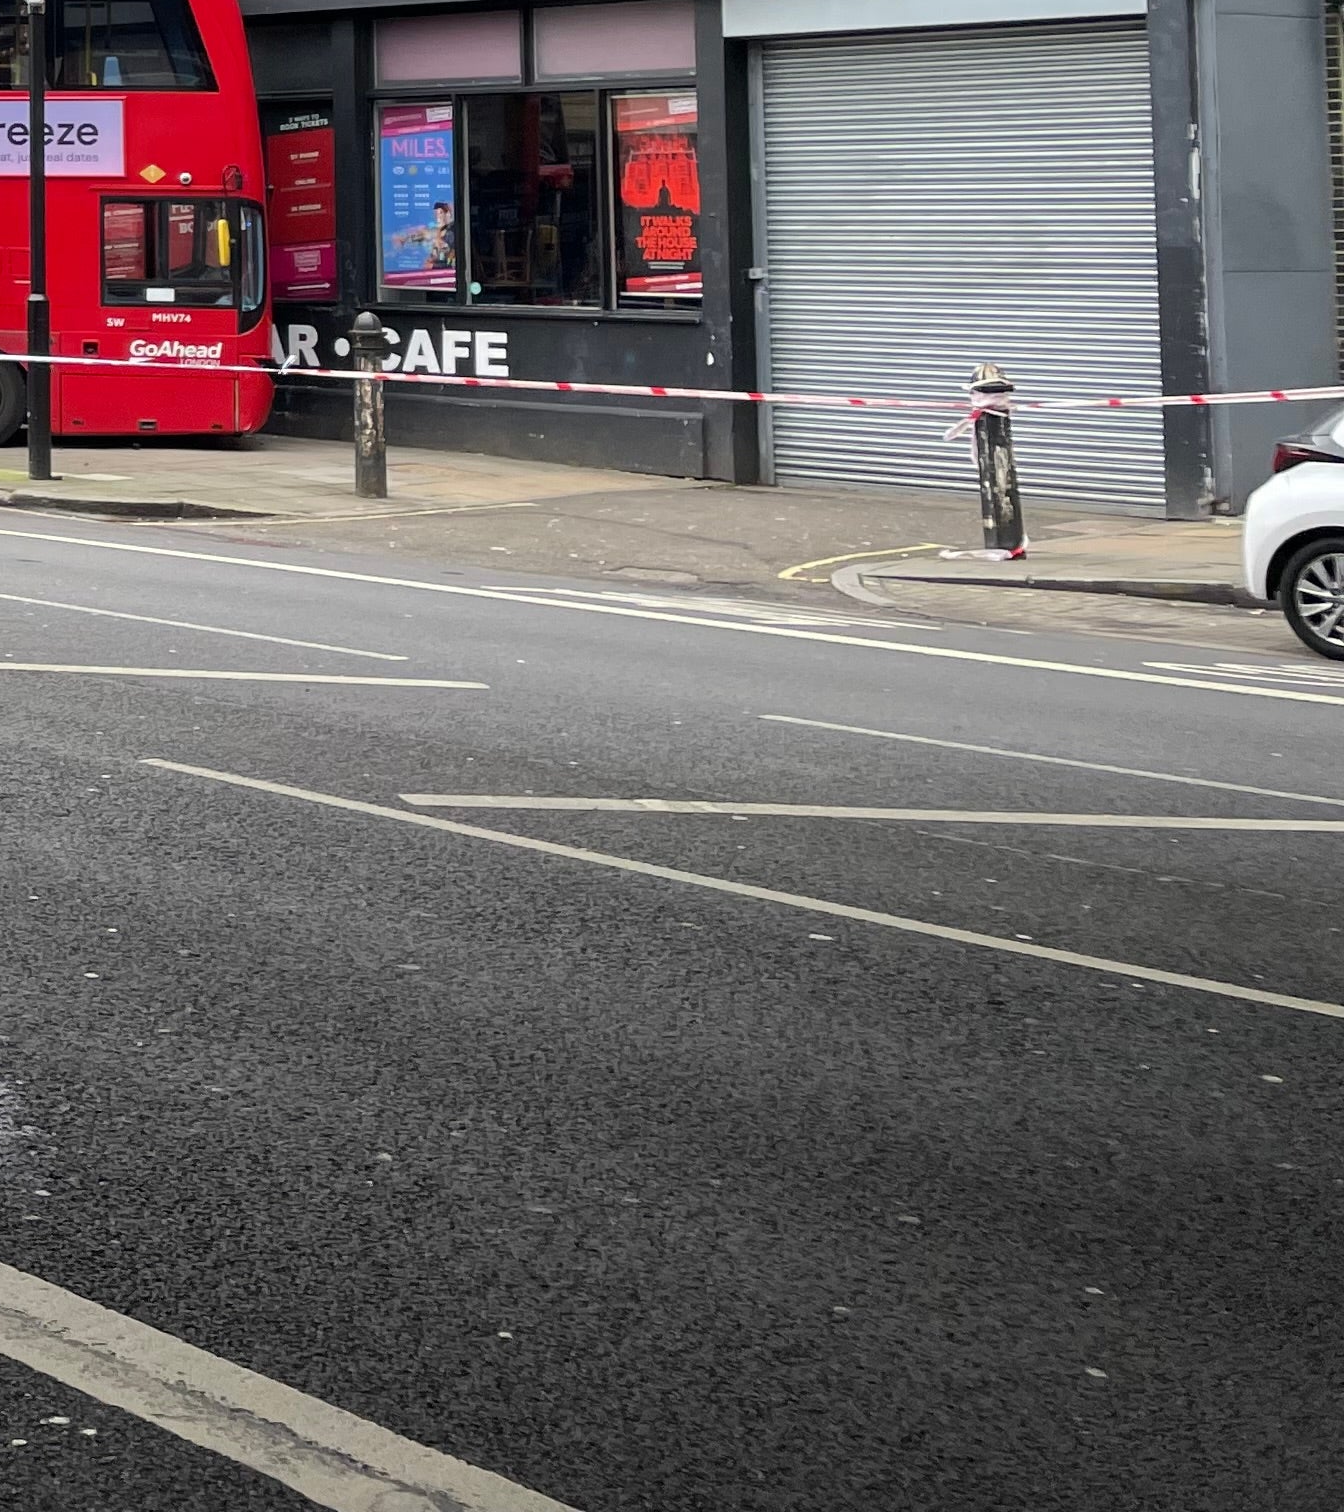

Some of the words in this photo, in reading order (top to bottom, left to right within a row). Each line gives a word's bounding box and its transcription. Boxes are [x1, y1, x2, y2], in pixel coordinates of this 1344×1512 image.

[300, 118, 328, 128] TICKETS
[17, 152, 31, 164] ju
[66, 152, 99, 162] dates
[651, 216, 692, 227] WALKS
[642, 227, 691, 237] AROUND
[635, 237, 657, 248] THE
[657, 237, 697, 249] HOUSE
[643, 248, 657, 260] AT
[657, 248, 694, 260] NIGHT
[106, 318, 125, 327] SW
[152, 313, 192, 323] MHV74
[129, 339, 223, 359] GoAhead
